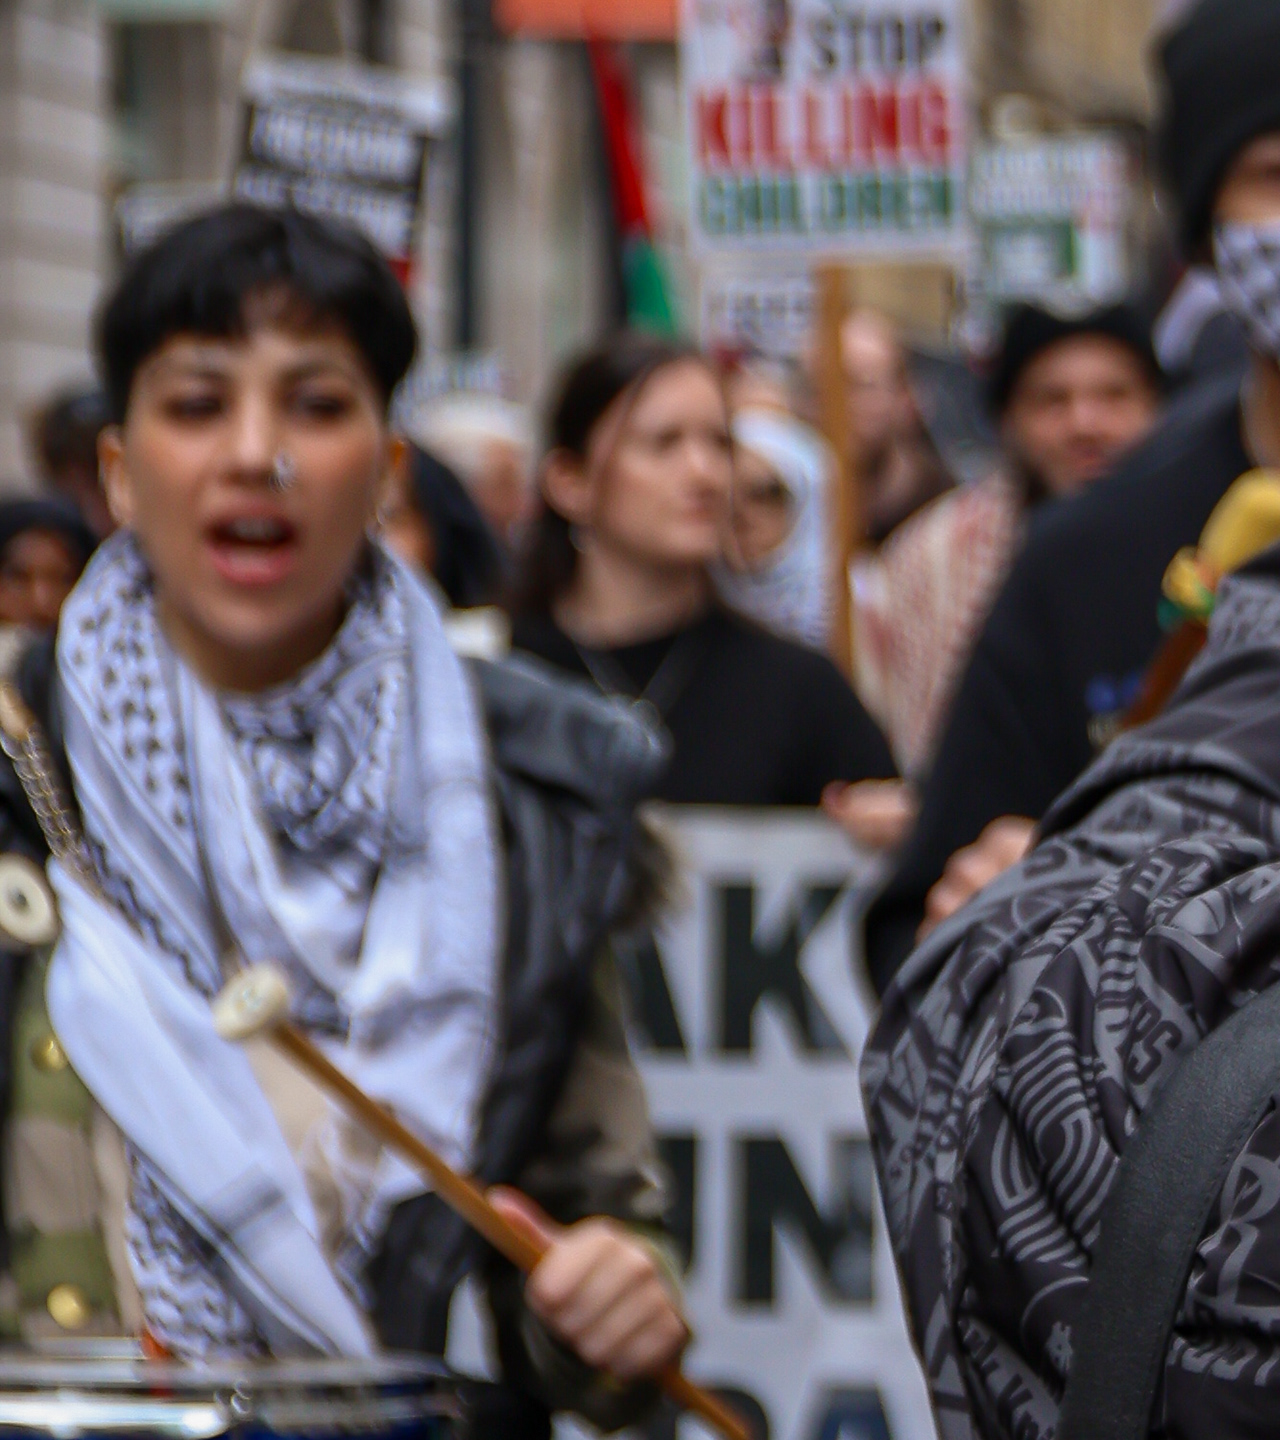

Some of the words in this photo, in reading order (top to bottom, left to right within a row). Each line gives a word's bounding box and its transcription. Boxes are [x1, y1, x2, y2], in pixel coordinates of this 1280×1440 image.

[811, 14, 946, 73] STOP
[695, 82, 954, 172] KILLING
[700, 172, 957, 237] CHILDREN
